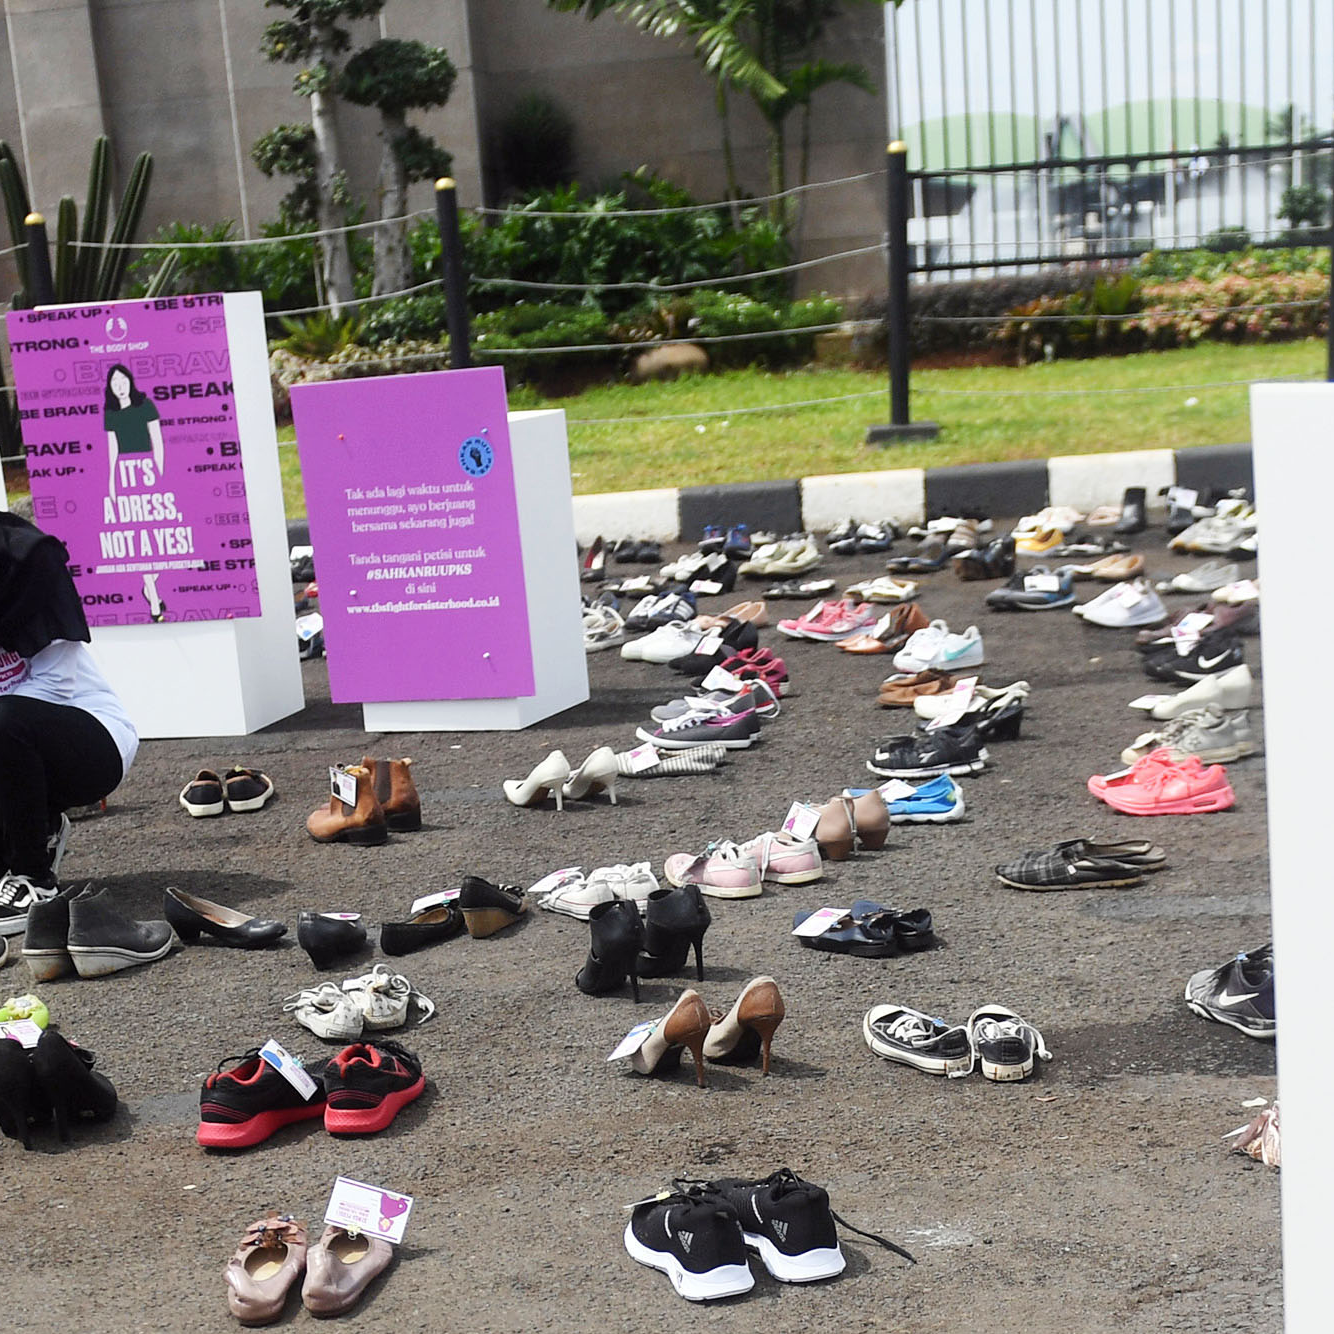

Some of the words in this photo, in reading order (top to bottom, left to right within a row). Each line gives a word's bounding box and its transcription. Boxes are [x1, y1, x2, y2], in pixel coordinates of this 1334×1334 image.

[153, 299, 179, 311] BE
[27, 310, 77, 323] SPEAK
[81, 308, 102, 318] UP
[90, 345, 105, 354] THE
[106, 343, 126, 353] BODY
[128, 341, 149, 351] SHOP
[20, 409, 39, 420] BE
[44, 404, 99, 418] BRAVE
[160, 418, 174, 426] BE
[177, 416, 227, 425] STRONG
[55, 466, 76, 476] UP
[119, 458, 156, 488] IT'S
[194, 462, 236, 473] SPEAK
[344, 488, 364, 500] Tak
[366, 486, 385, 499] ada
[386, 485, 406, 499] lagi
[407, 483, 440, 496] waktu
[442, 480, 474, 493] untuk
[103, 496, 117, 525] A
[121, 491, 183, 525] DRESS,
[347, 504, 406, 517] menunggu,
[407, 502, 427, 515] ayo
[428, 499, 475, 512] berjuang
[352, 521, 397, 533] bersama
[399, 517, 446, 529] sekarang
[448, 513, 474, 528] juga!
[99, 531, 136, 559] NOT
[140, 529, 153, 556] A
[153, 526, 195, 555] YES!
[349, 552, 381, 565] Tanda
[382, 550, 421, 564] tangani
[423, 549, 453, 564] petisi
[454, 546, 486, 559] untuk
[366, 563, 473, 581] #SAHKANRUUPKS
[178, 584, 214, 593] SPEAK
[216, 583, 231, 591] UP
[405, 583, 416, 594] di
[417, 582, 436, 594] sini
